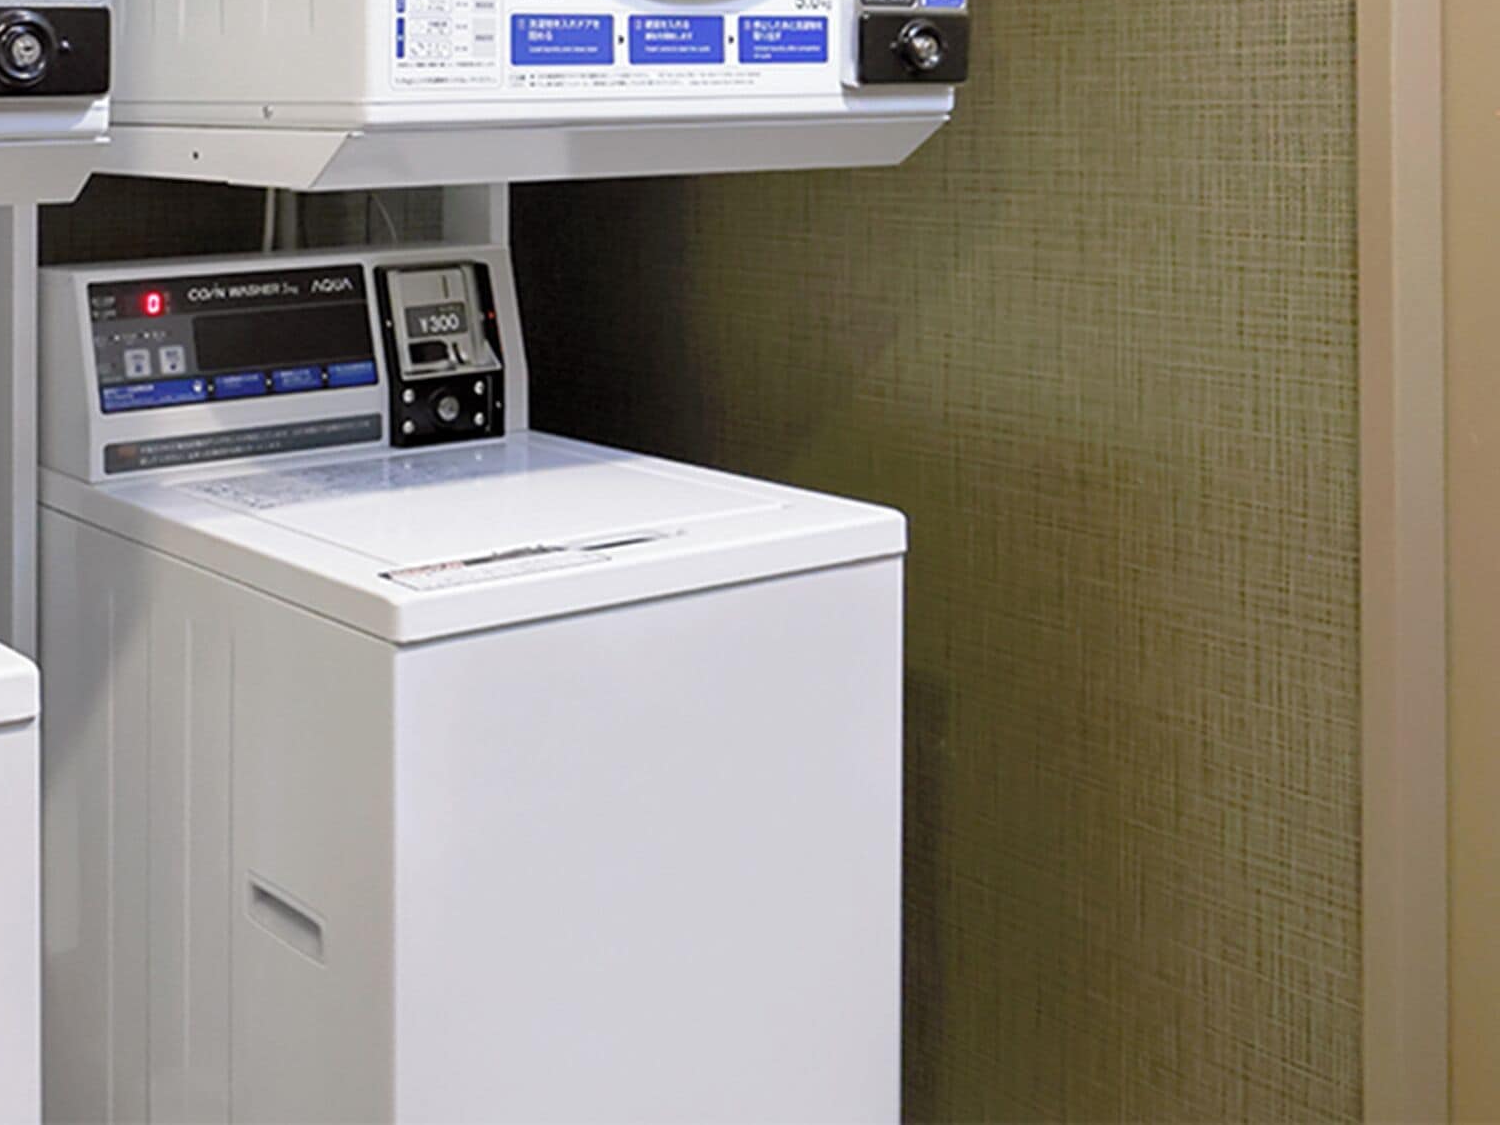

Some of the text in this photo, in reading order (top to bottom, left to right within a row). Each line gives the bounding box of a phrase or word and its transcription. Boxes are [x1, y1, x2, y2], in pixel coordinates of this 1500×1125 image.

[228, 283, 279, 300] WASHER
[311, 276, 353, 293] AQUA
[146, 294, 160, 314] 0
[418, 313, 460, 335] ¥300
